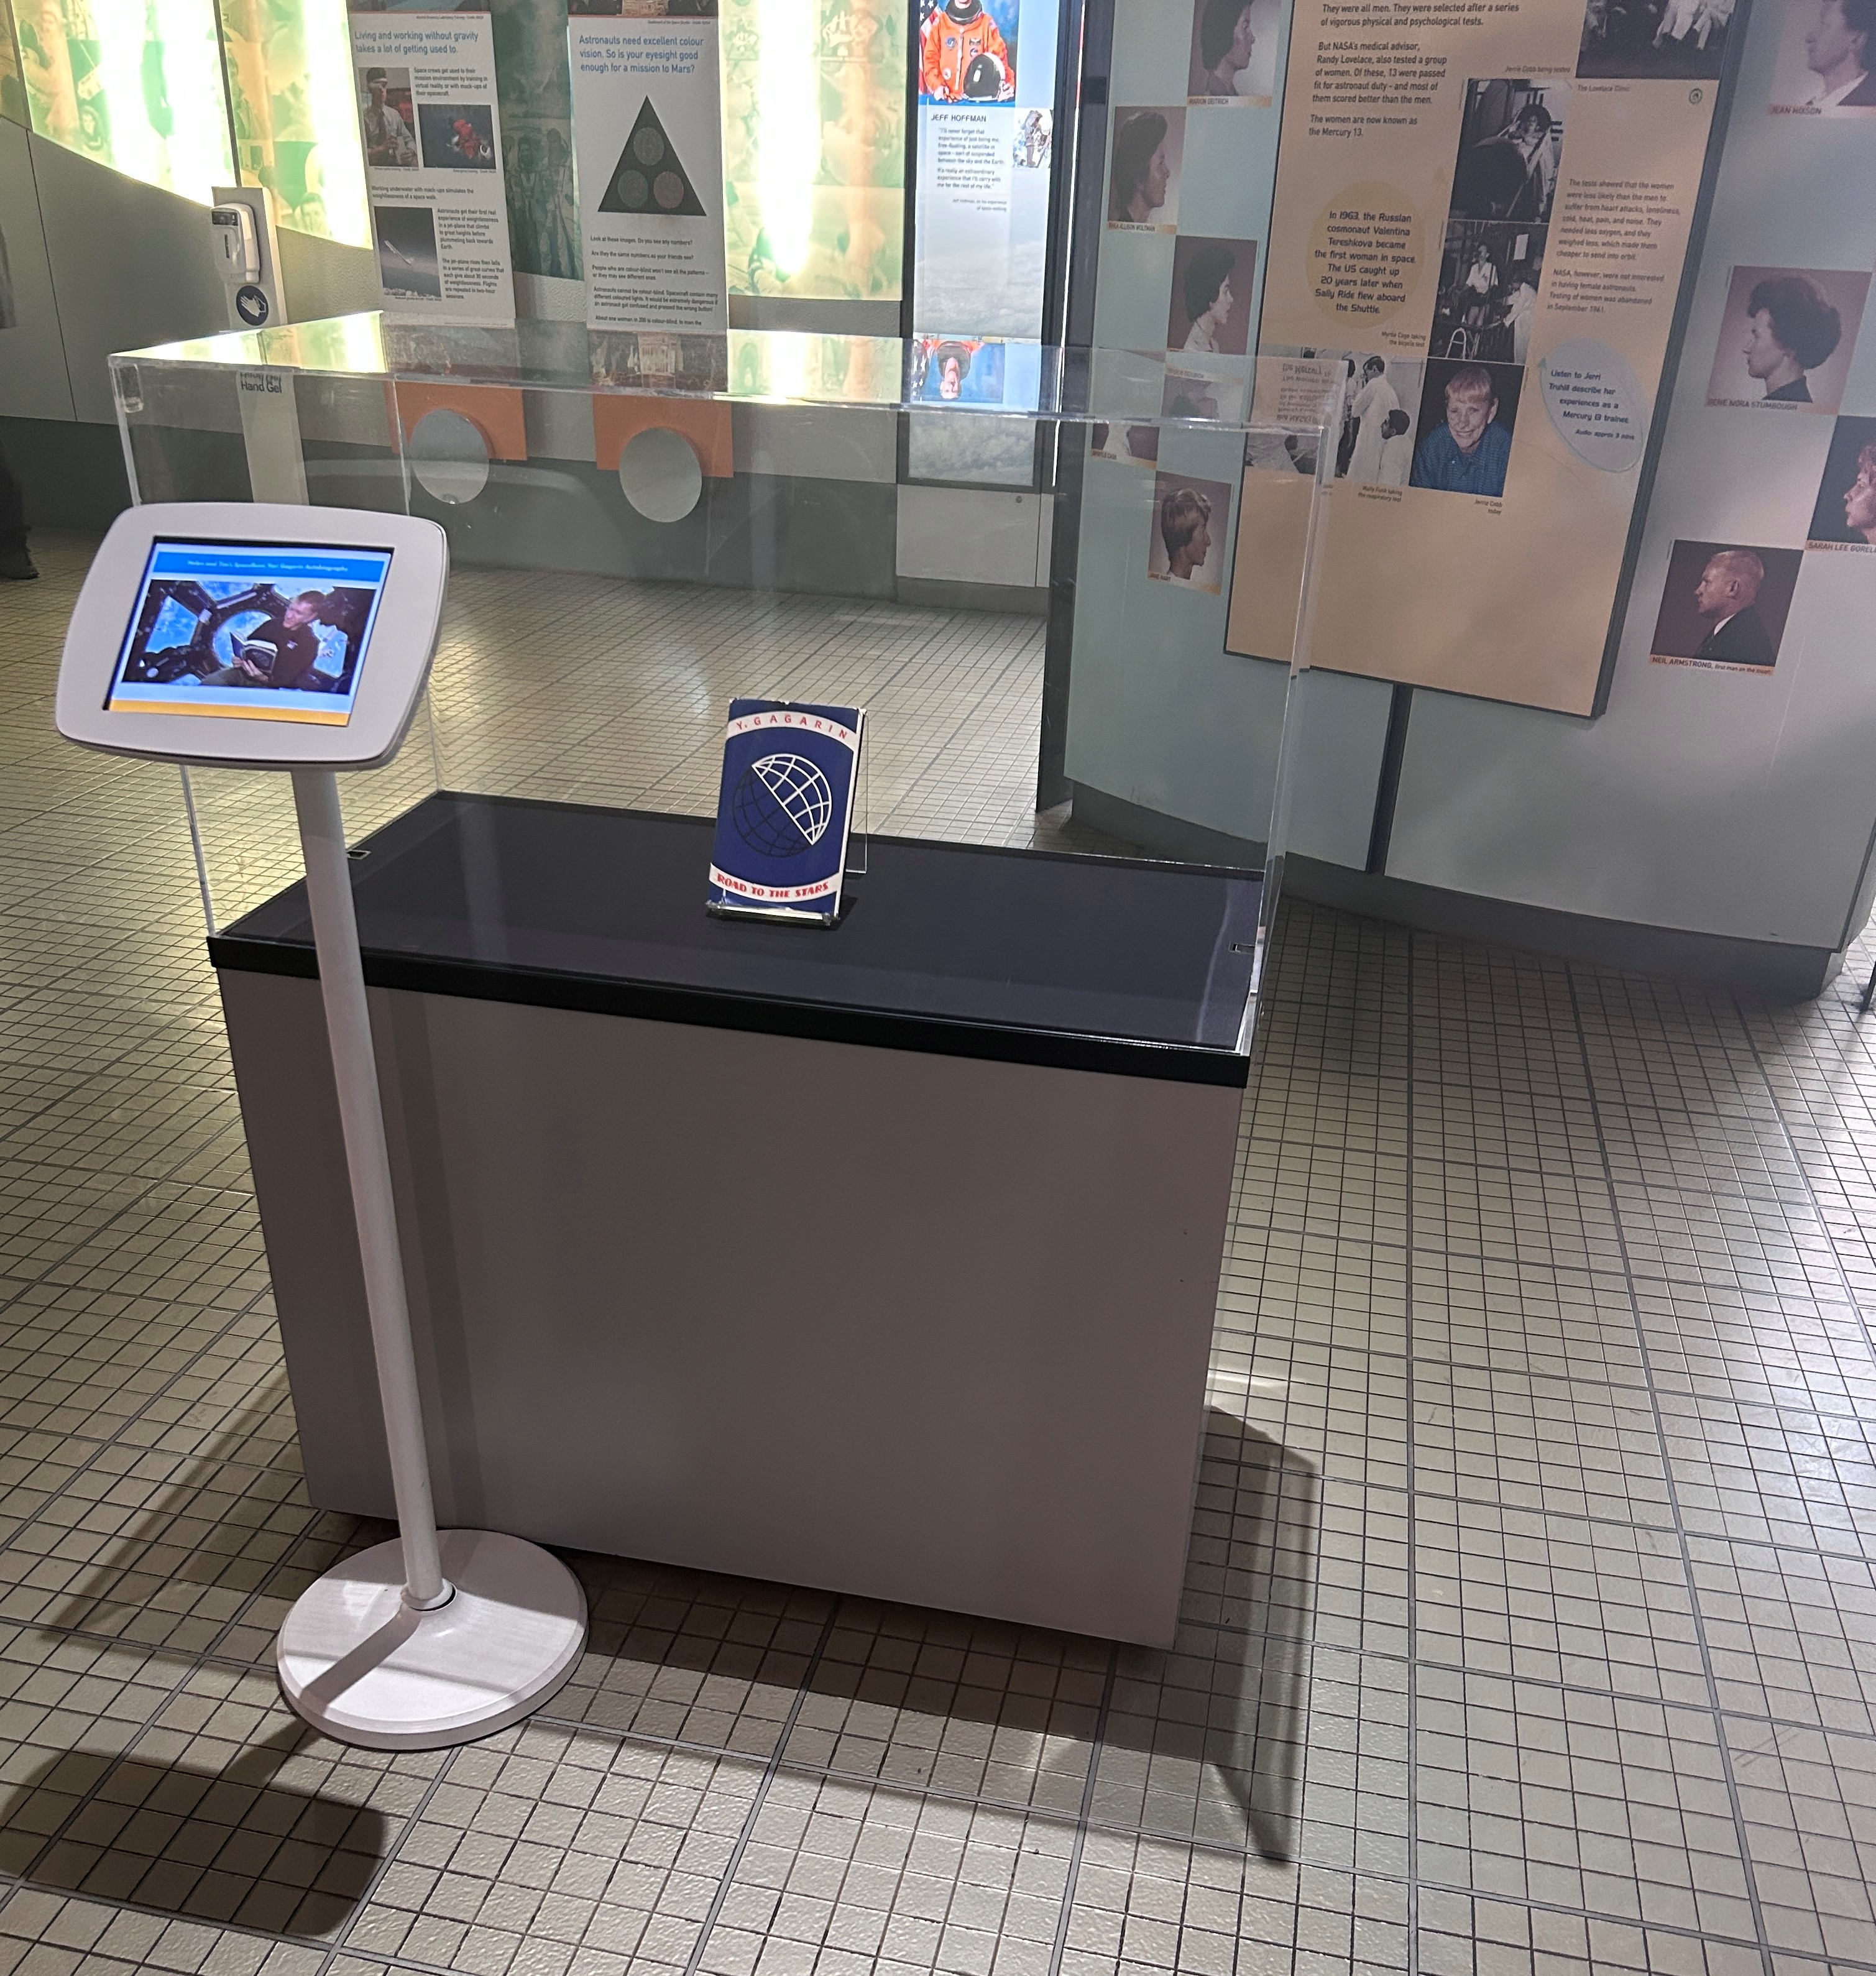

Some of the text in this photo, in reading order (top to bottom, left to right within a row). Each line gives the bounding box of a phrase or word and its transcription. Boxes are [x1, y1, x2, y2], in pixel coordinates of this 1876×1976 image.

[1323, 4, 1339, 14] They
[1361, 4, 1370, 12] all
[1393, 3, 1411, 14] They
[1433, 4, 1465, 12] selected
[1495, 3, 1519, 11] series
[1330, 18, 1360, 27] vigorous
[1362, 18, 1392, 27] physical
[1410, 17, 1460, 27] psychological
[1463, 17, 1483, 25] tests.
[355, 30, 478, 42] Living and working without gravity
[579, 35, 704, 46] Astronauts need excellent colour
[356, 44, 375, 53] takes
[383, 44, 392, 52] lot
[394, 44, 401, 52] of
[403, 45, 428, 55] getting
[430, 45, 447, 53] used
[1318, 42, 1330, 50] But
[1360, 42, 1389, 50] medical
[1391, 42, 1420, 51] advisor,
[580, 48, 698, 61] vision. So is your eyesight good
[1317, 55, 1338, 65] Randy
[1341, 55, 1374, 64] Lovelace,
[1425, 57, 1447, 65] group
[581, 63, 609, 73] enough
[611, 63, 621, 71] for
[630, 64, 660, 73] mission
[662, 65, 669, 73] to
[671, 65, 694, 73] Mars?
[1316, 68, 1323, 76] of
[1354, 68, 1363, 76] Of
[1364, 68, 1386, 77] these,
[1389, 68, 1397, 76] 13
[1419, 69, 1445, 78] passed
[1371, 82, 1387, 91] duty
[1394, 82, 1408, 90] and
[1430, 82, 1438, 90] of
[1313, 94, 1331, 103] them
[1382, 95, 1398, 103] than
[1311, 114, 1323, 123] The
[1383, 116, 1407, 124] known
[1309, 127, 1363, 138] the Mercury 13.
[1364, 213, 1376, 221] the
[1379, 213, 1412, 223] Russian
[1327, 225, 1410, 236] cosmonaut Valentina
[1329, 237, 1405, 249] Tereshkova became
[1315, 250, 1327, 258] the
[1330, 250, 1346, 259] first
[1328, 264, 1341, 272] The
[1345, 264, 1356, 273] US
[1359, 266, 1386, 276] caught
[1321, 276, 1403, 288] 20 years later when
[1315, 288, 1405, 302] Sally Ride flew aboard
[1336, 303, 1348, 311] the
[241, 380, 282, 393] Hand Gel
[1572, 385, 1601, 393] describe
[1560, 399, 1599, 407] experiences
[1563, 411, 1592, 421] Mercury
[1808, 541, 1833, 550] SARAH
[754, 715, 847, 739] GAGARIN
[717, 873, 829, 898] ROAD TO THE STARS
